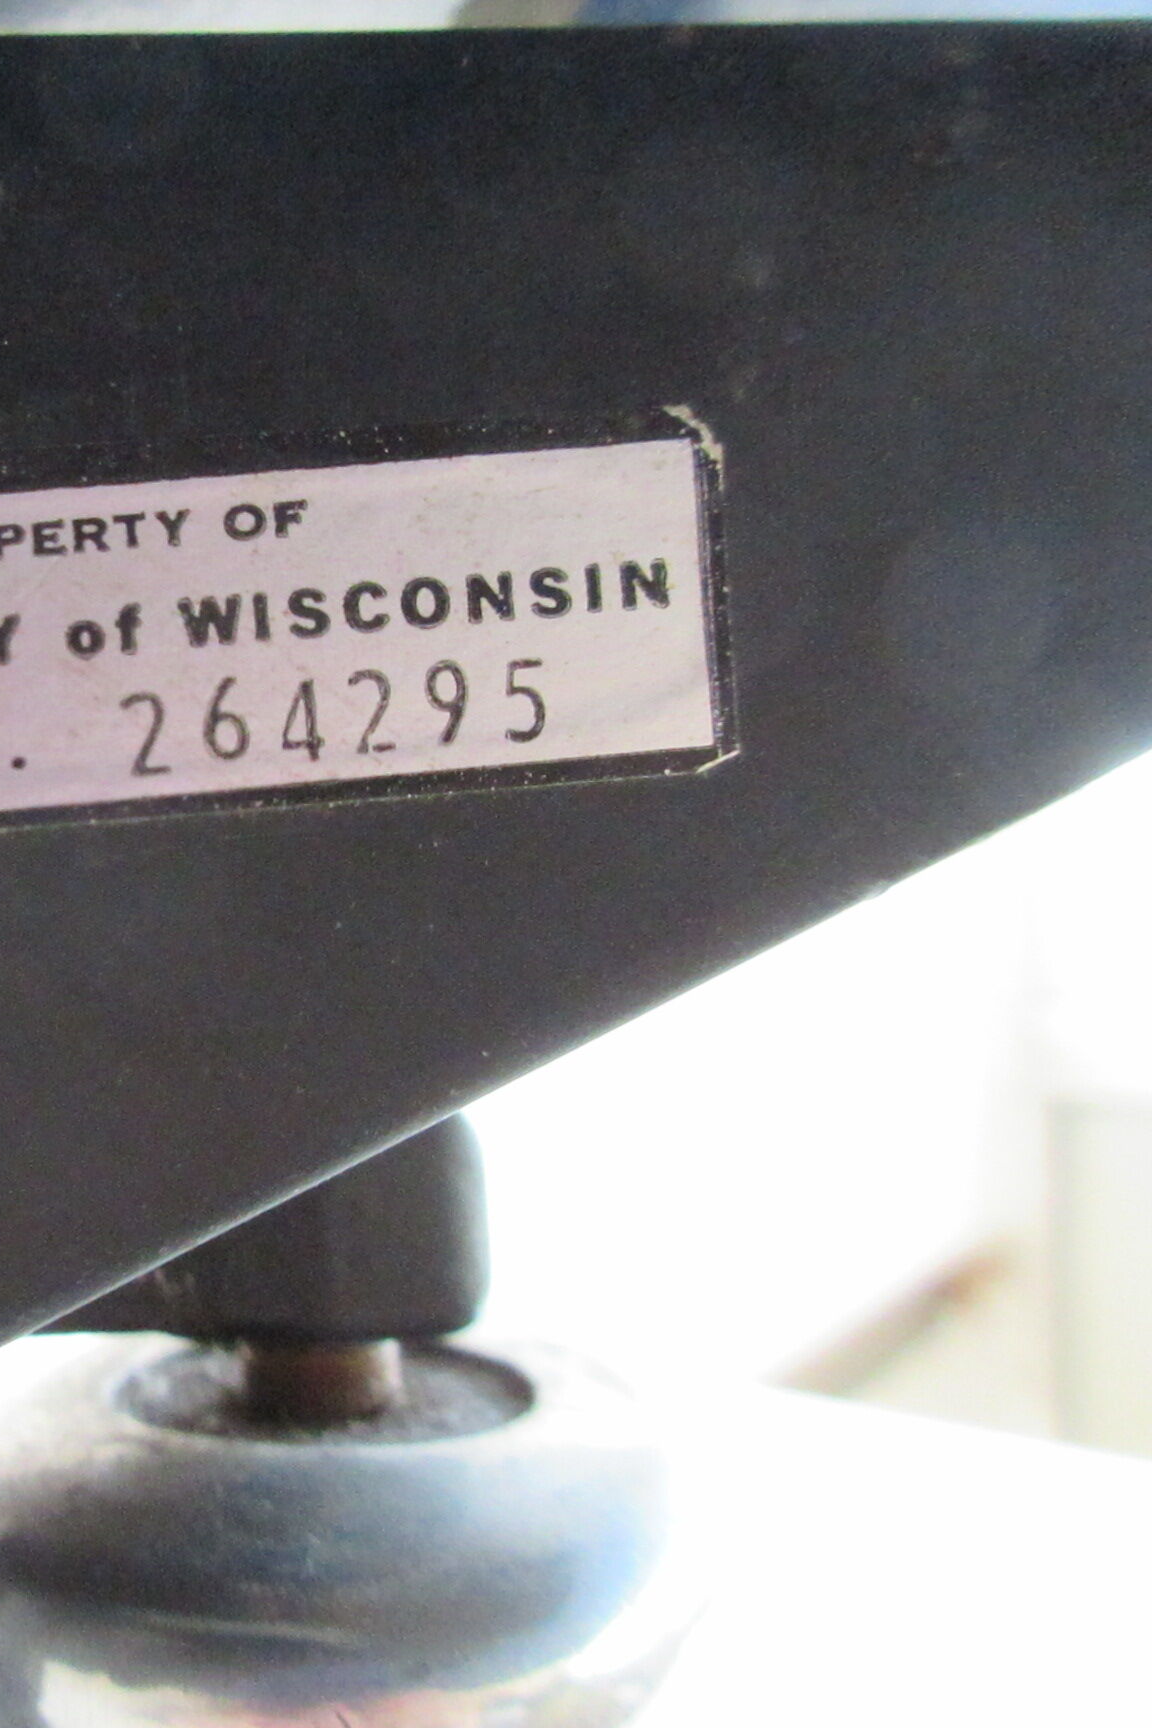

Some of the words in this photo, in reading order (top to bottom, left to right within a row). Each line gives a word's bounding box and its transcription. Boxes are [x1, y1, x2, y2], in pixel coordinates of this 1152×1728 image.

[224, 500, 307, 541] OF
[66, 601, 142, 659] of
[178, 558, 671, 648] WISCONSIN
[121, 658, 546, 777] 264295
